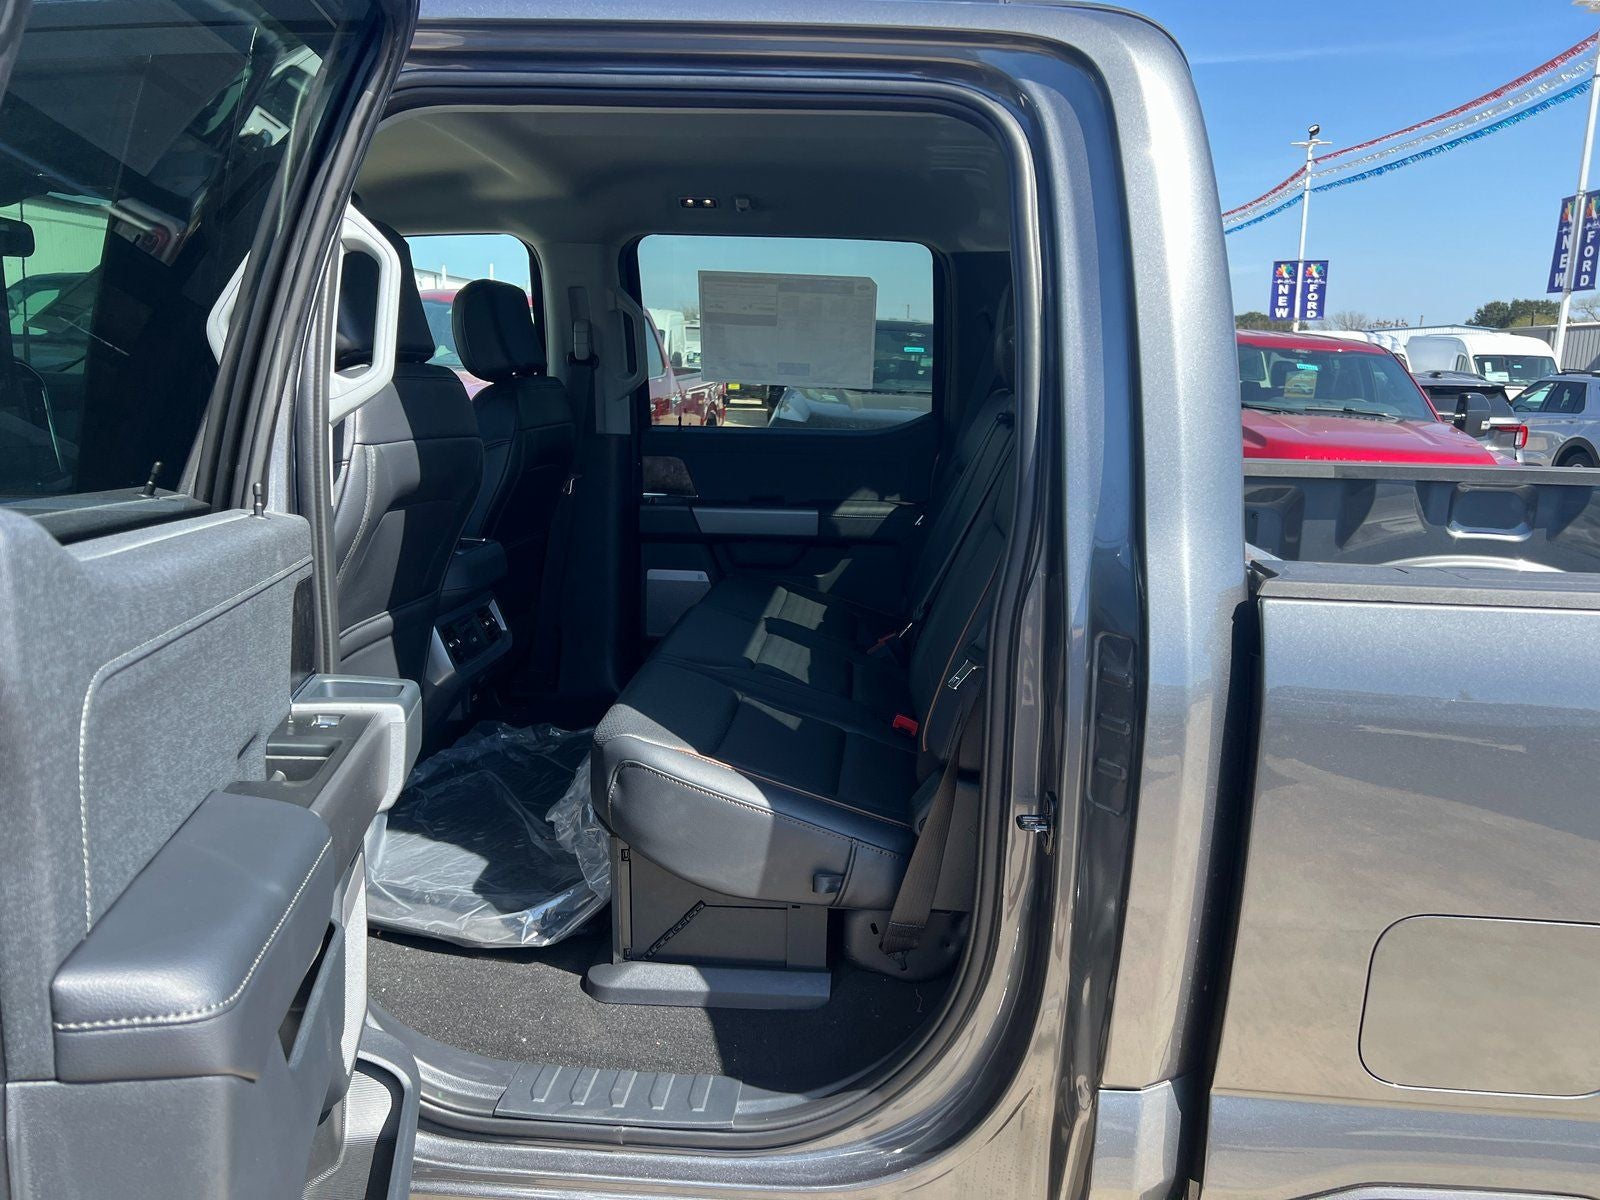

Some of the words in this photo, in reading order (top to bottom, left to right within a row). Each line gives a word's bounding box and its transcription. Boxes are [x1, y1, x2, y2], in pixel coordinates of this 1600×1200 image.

[1579, 230, 1596, 287] FORD
[1274, 284, 1289, 318] NEW
[1306, 284, 1319, 319] FORD
